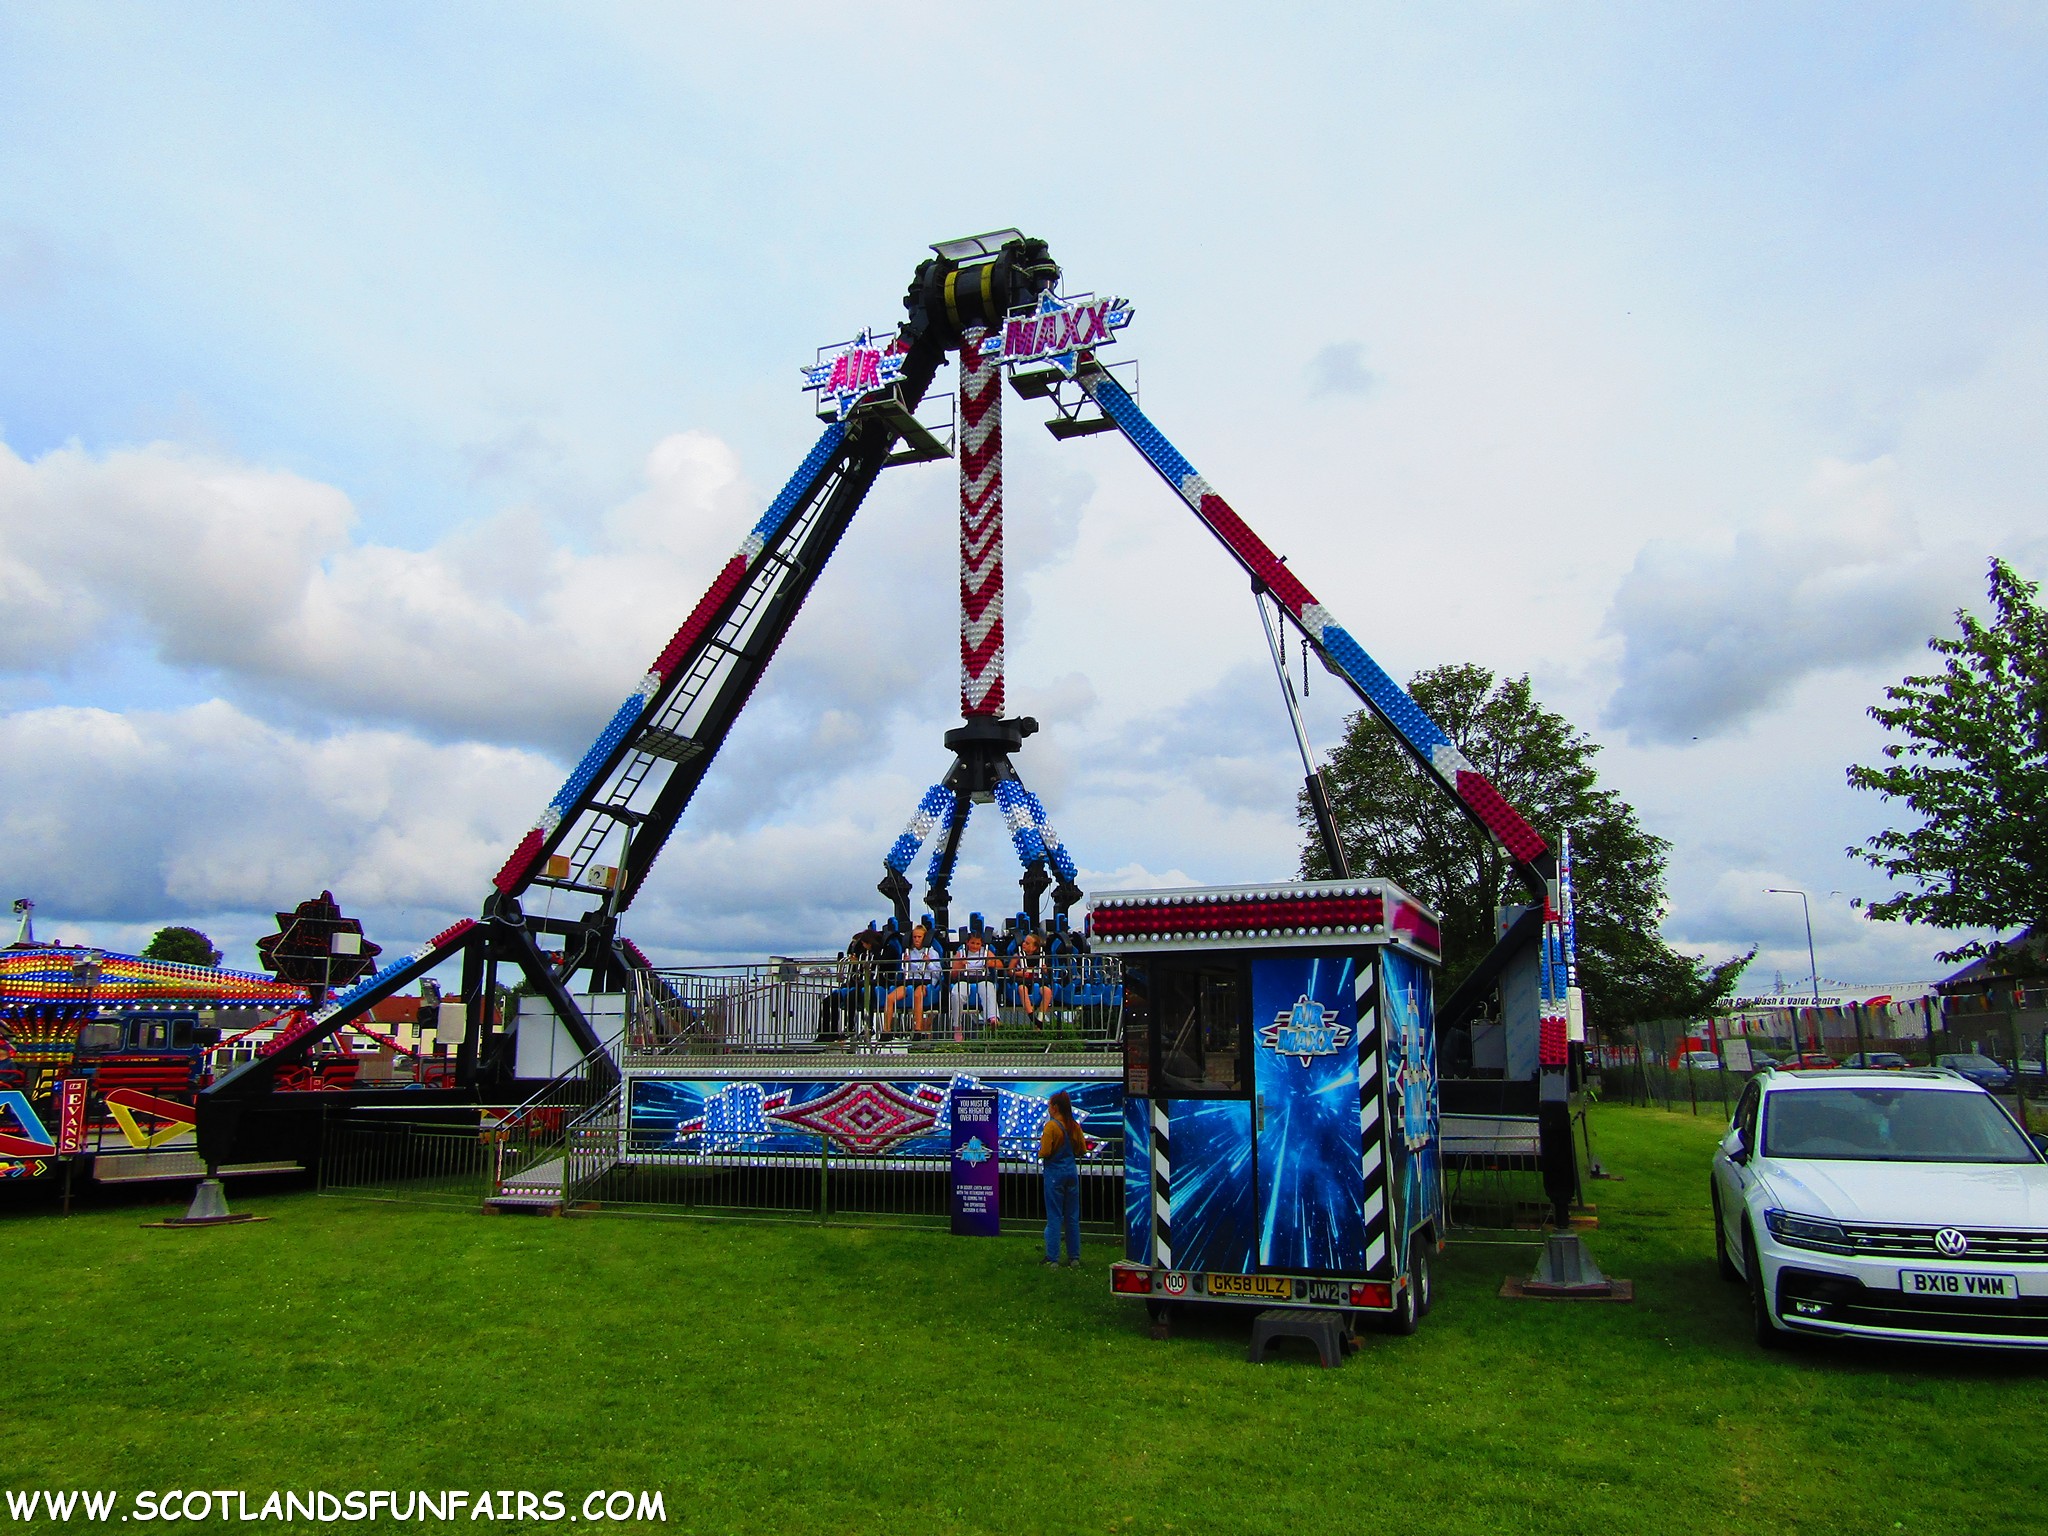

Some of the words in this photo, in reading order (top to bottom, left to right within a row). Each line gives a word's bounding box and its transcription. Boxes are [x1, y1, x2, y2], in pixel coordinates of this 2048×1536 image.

[1003, 299, 1112, 357] MAXX
[826, 347, 881, 393] AIR
[1754, 997, 1777, 1006] Wash
[1779, 997, 1785, 1005] &
[1787, 997, 1809, 1005] Valet
[1811, 997, 1841, 1005] Centre
[1290, 1003, 1324, 1028] AIR
[1277, 1029, 1336, 1053] MAXX
[960, 1114, 972, 1122] OVER
[972, 1114, 979, 1122] TO
[979, 1114, 990, 1122] RIDE
[968, 1107, 985, 1115] HEIGHT
[984, 1107, 992, 1115] OR
[65, 1093, 82, 1150] EVANS
[1167, 1272, 1184, 1288] 100
[1214, 1275, 1252, 1293] GK58
[1255, 1277, 1285, 1294] ULZ
[1914, 1274, 1959, 1293] BX18
[1964, 1276, 2005, 1295] VMM
[1310, 1281, 1340, 1300] JW2
